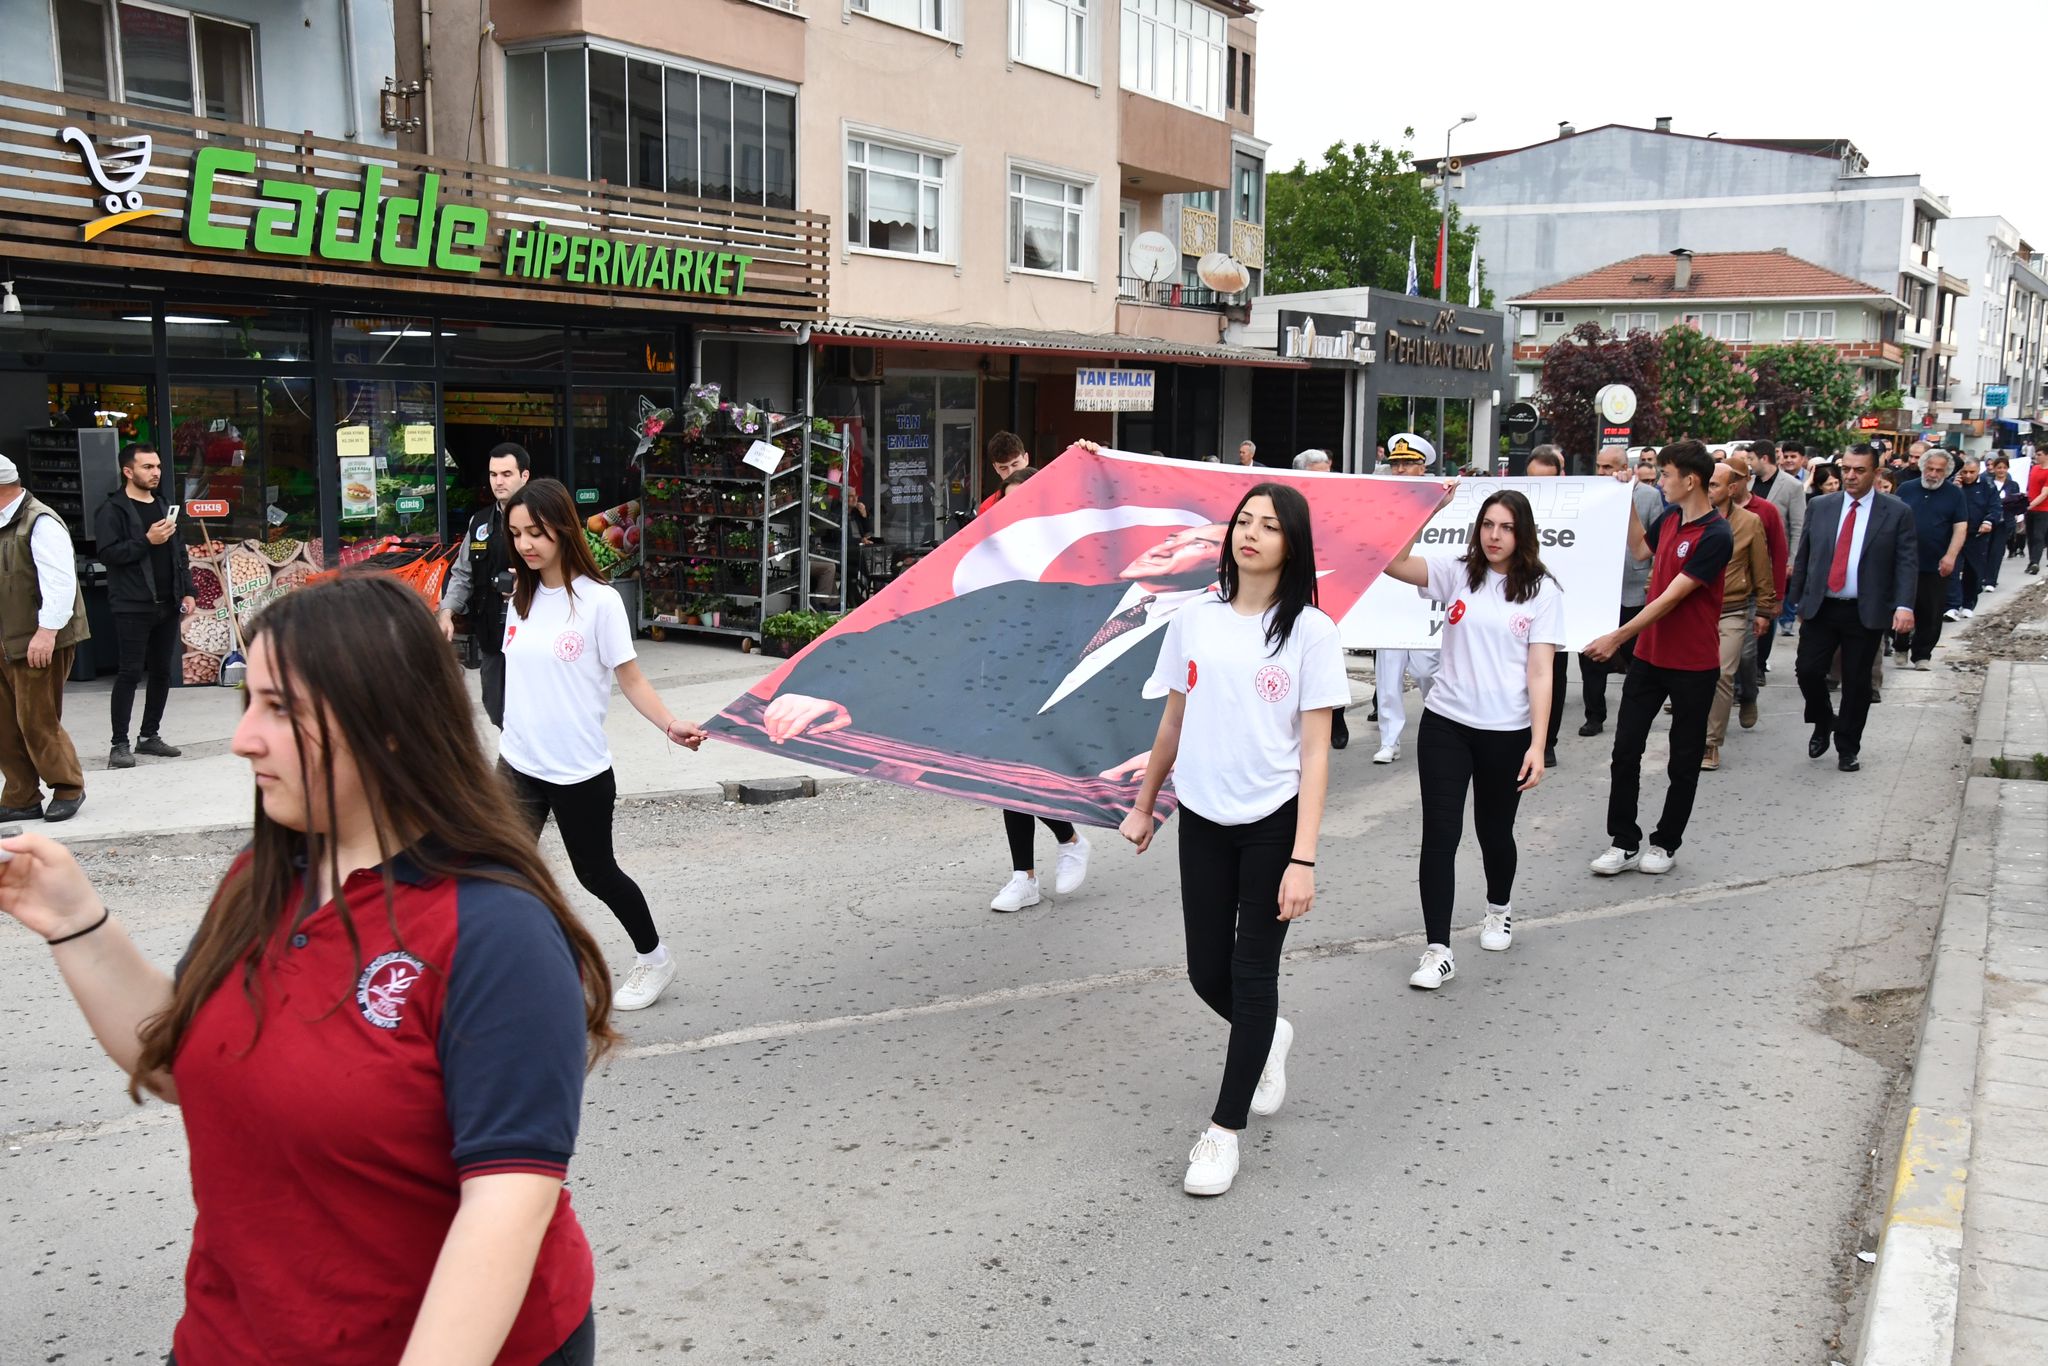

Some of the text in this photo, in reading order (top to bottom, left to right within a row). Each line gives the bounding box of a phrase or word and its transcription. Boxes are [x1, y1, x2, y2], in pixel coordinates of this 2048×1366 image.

[188, 146, 753, 297] Cadde HİPERMARKET
[1455, 343, 1494, 371] EMLAK
[1078, 370, 1152, 387] TAN EMLAK
[896, 414, 921, 429] TAN
[887, 434, 929, 450] EMLAK
[193, 503, 222, 513] ÇIKIŞ
[400, 500, 420, 509] GİRİŞ
